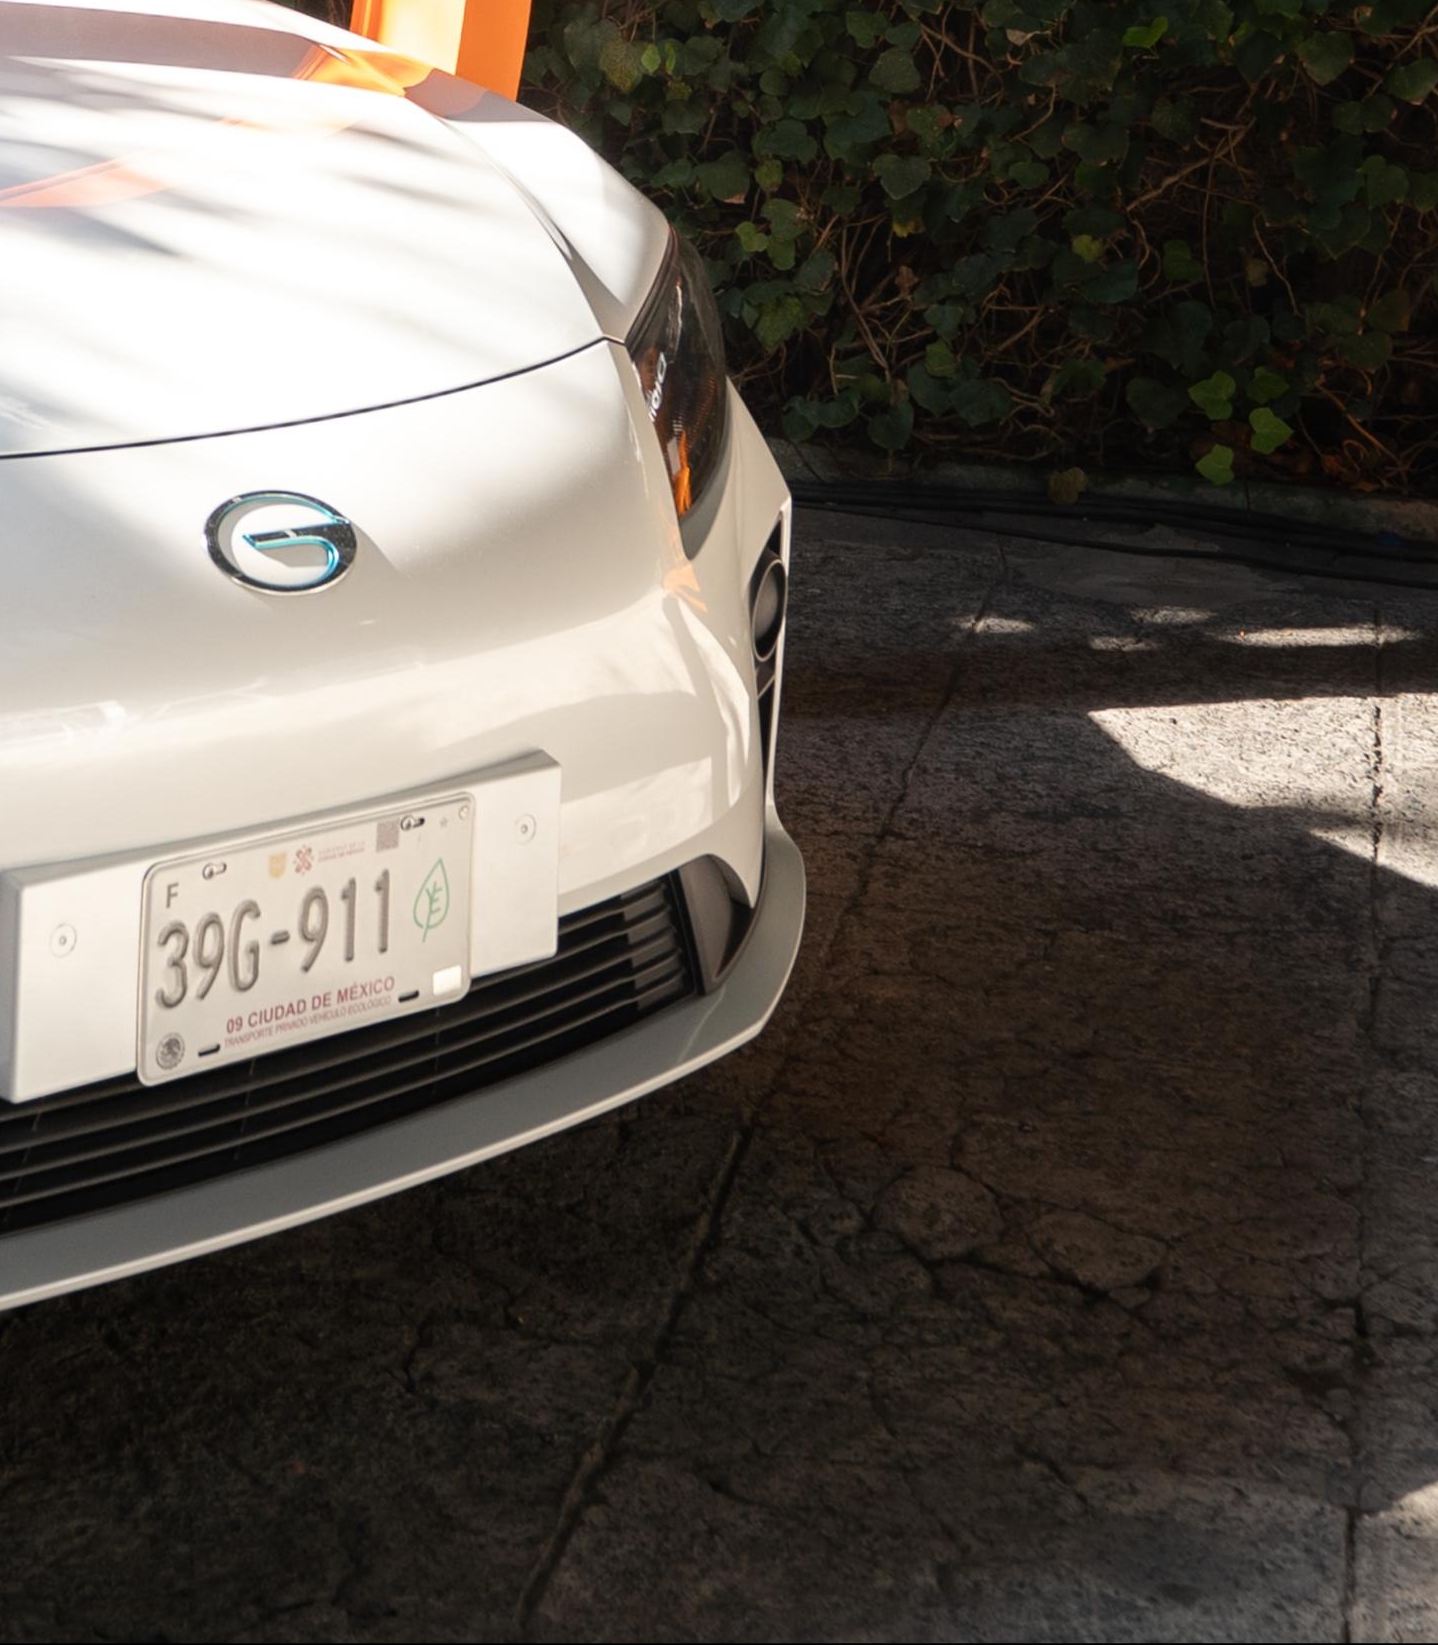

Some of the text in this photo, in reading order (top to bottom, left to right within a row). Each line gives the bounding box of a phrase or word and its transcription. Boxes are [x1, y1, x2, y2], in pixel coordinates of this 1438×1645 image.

[165, 883, 179, 908] F
[155, 869, 390, 1009] 39G-911
[226, 976, 396, 1034] 09 CIUDAD DE MÉXICO
